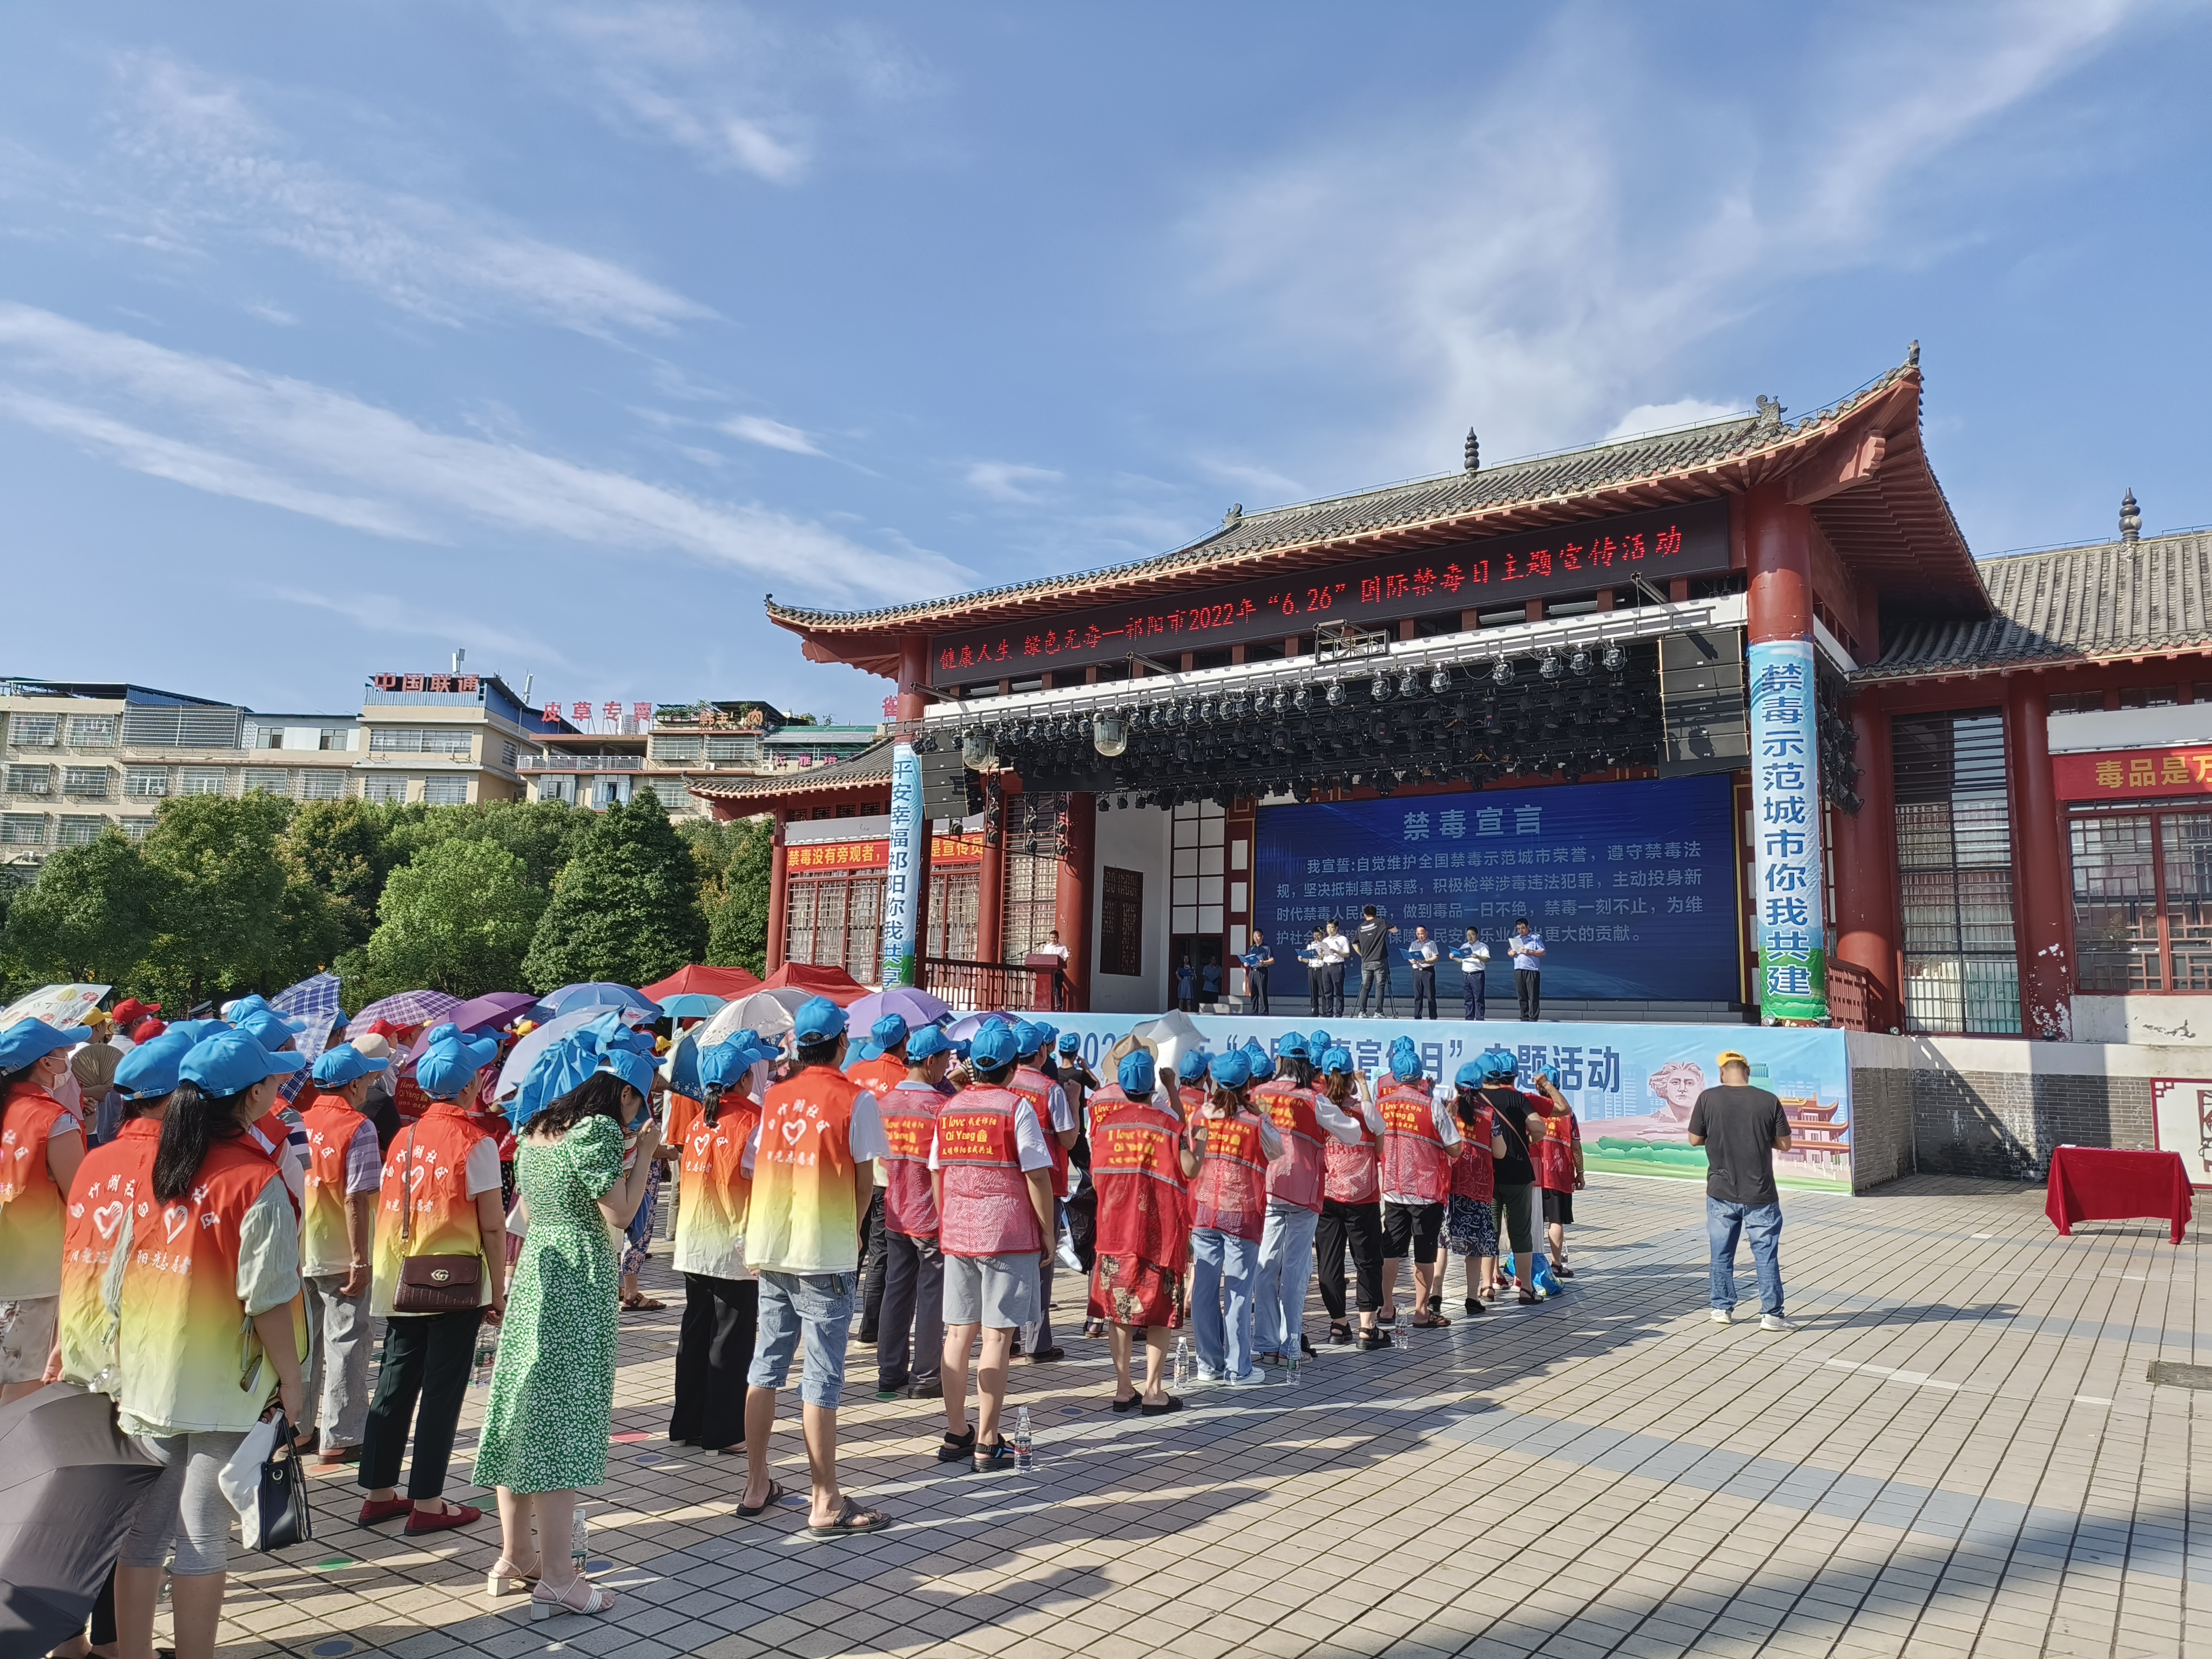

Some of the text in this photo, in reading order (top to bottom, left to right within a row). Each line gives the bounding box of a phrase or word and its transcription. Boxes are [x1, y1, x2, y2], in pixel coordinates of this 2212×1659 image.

[375, 672, 479, 693] 中国联通
[1404, 805, 1542, 841] 禁毒宣言
[1762, 663, 1811, 996] 禁毒示范城市你我共建
[882, 760, 913, 987] 平安幸福祁阳你我共享
[941, 1117, 947, 1129] I
[949, 1116, 966, 1128] love
[946, 1130, 976, 1142] Qi Yang
